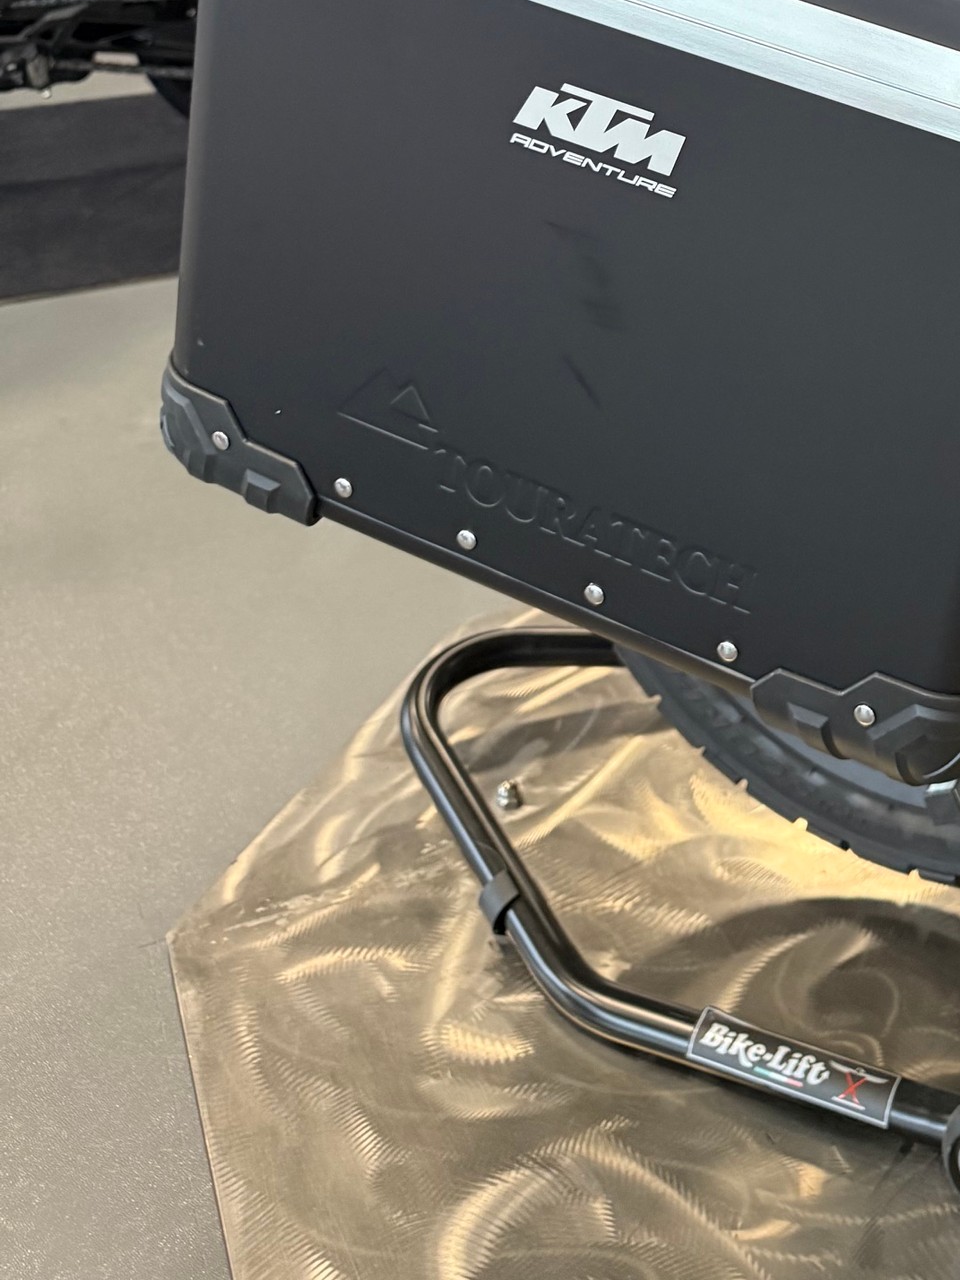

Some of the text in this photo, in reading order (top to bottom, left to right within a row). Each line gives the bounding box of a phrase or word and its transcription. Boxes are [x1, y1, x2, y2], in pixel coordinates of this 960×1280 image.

[510, 132, 677, 199] ADVENTURE
[512, 82, 686, 177] KTM
[433, 443, 758, 614] TOURATECH
[699, 1022, 830, 1086] Bike-Lift
